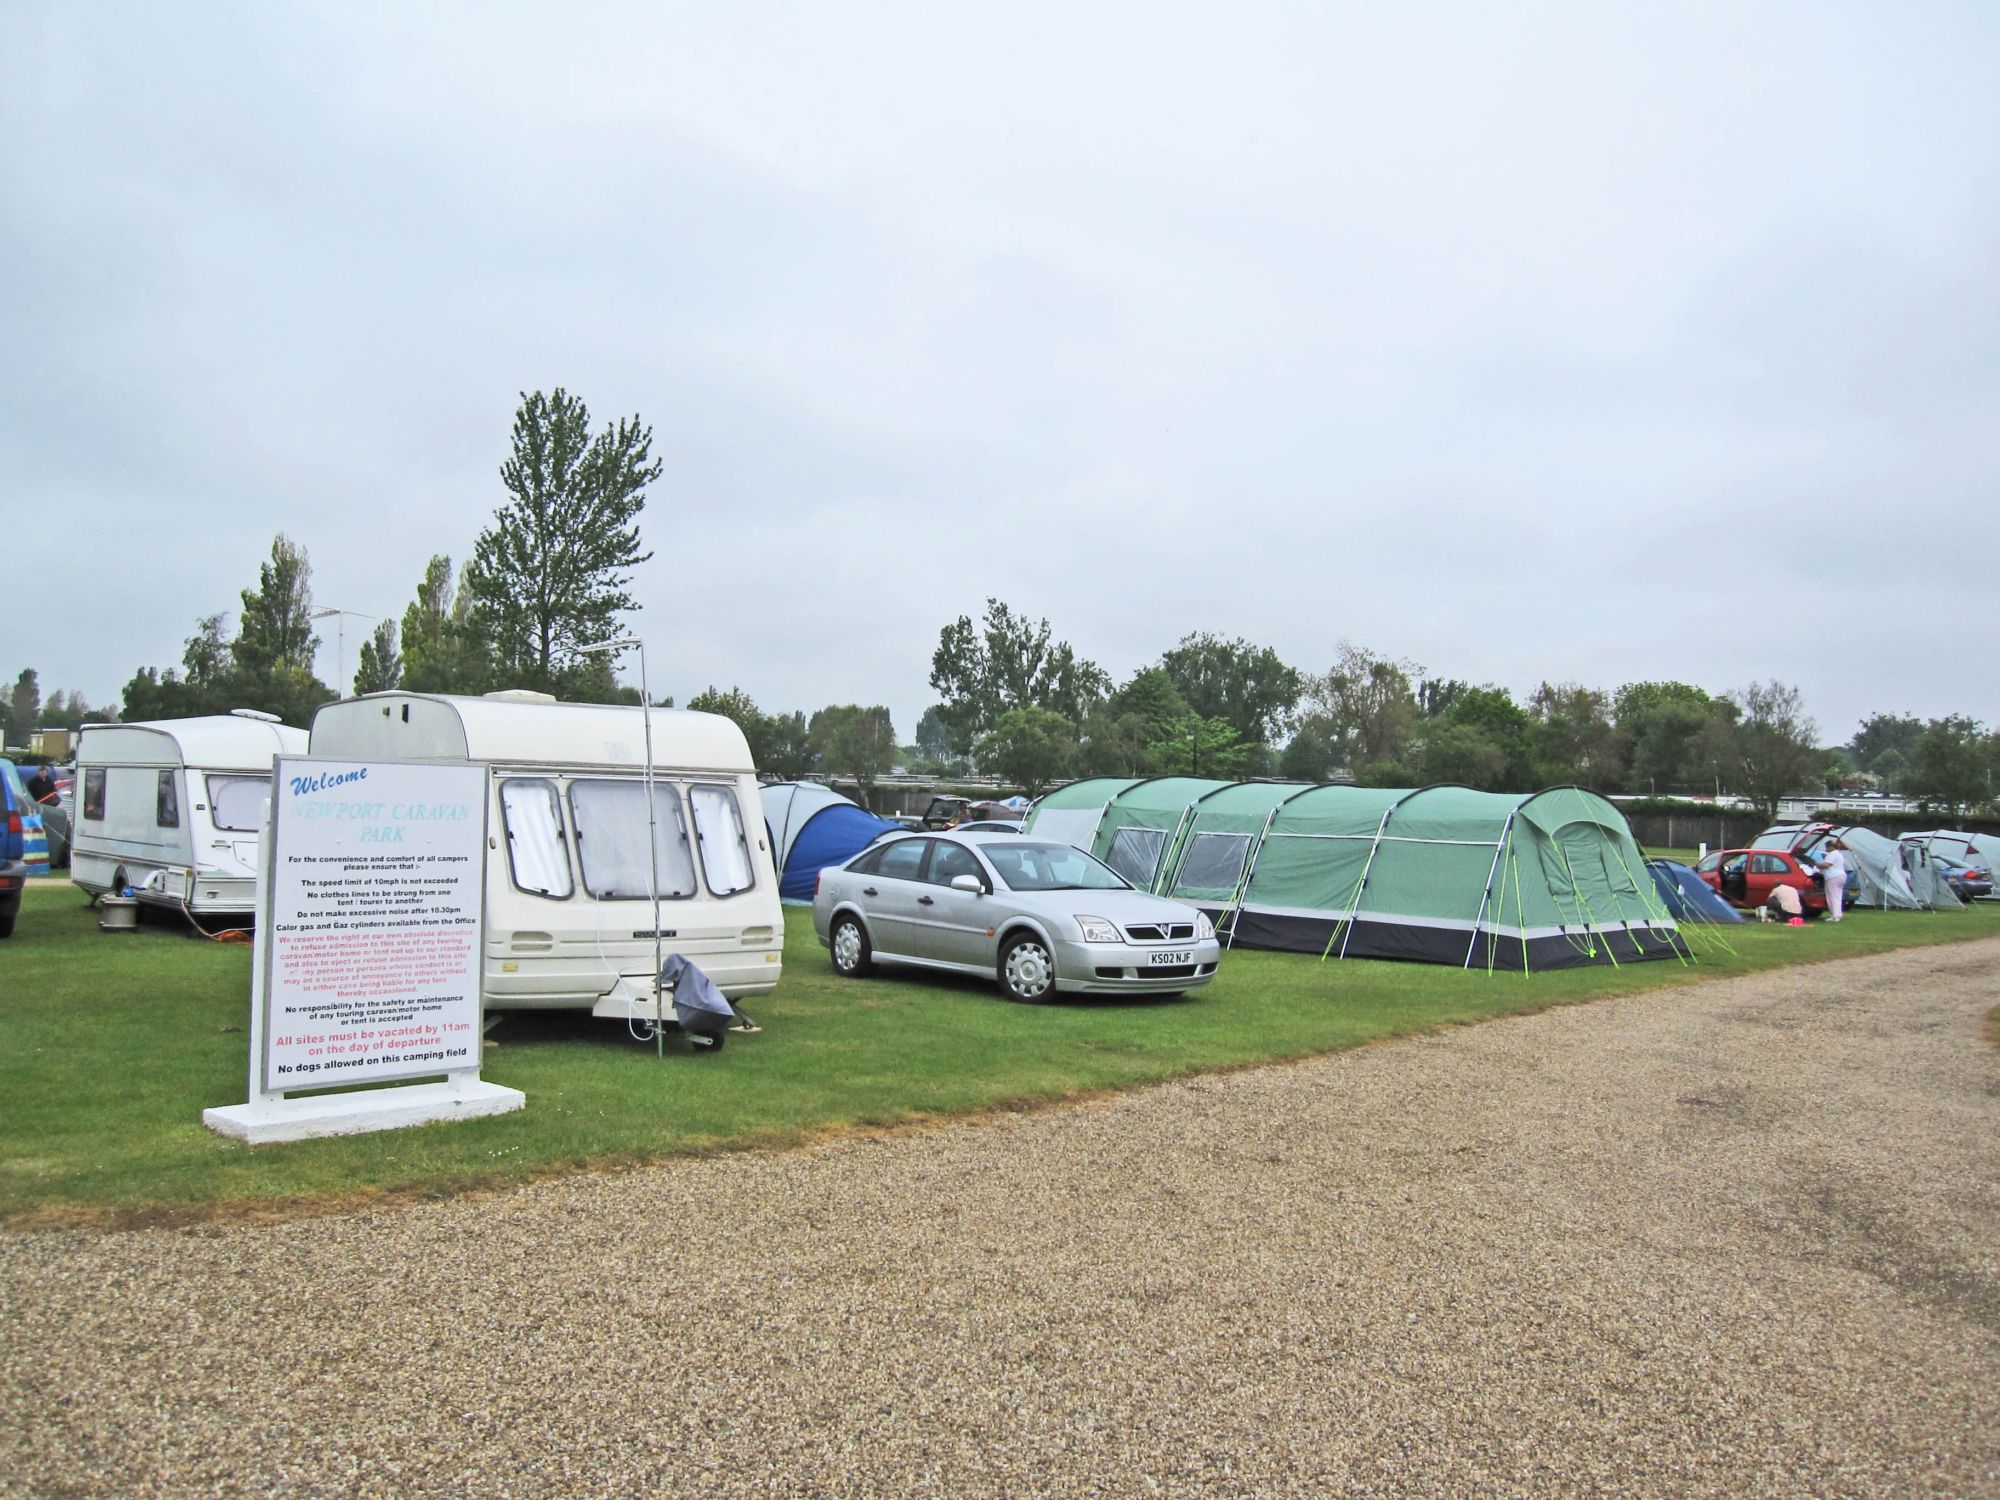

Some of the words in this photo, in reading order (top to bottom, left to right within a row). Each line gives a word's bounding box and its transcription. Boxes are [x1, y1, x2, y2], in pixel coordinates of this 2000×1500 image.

[290, 768, 368, 796] Welcome
[291, 802, 385, 819] NEWPORT
[391, 803, 471, 820] CARAVAN
[360, 826, 406, 842] PARK
[343, 864, 369, 872] please
[319, 879, 343, 887] speed
[374, 878, 400, 886] 10mph
[350, 921, 385, 929] cylinders
[387, 919, 421, 927] available
[341, 934, 360, 942] right
[328, 941, 369, 949] admission
[330, 958, 351, 966] eject
[1151, 954, 1174, 963] KS02
[1176, 952, 1191, 963] NJF
[316, 968, 345, 976] person
[440, 967, 466, 975] without
[312, 983, 337, 991] either
[337, 989, 367, 997] thereby
[299, 1002, 353, 1013] responsibility
[416, 996, 463, 1004] maintenance
[378, 1013, 413, 1023] accepted
[277, 1036, 293, 1046] All
[295, 1034, 325, 1044] sites
[328, 1030, 359, 1042] must
[361, 1030, 375, 1039] be
[378, 1025, 423, 1037] vacated
[424, 1024, 438, 1035] by
[442, 1022, 470, 1032] 11am
[309, 1048, 323, 1056] on
[326, 1044, 345, 1054] the
[349, 1042, 371, 1053] day
[373, 1040, 384, 1050] of
[388, 1036, 441, 1049] departure
[278, 1064, 293, 1073] No
[296, 1063, 321, 1073] dogs
[324, 1057, 364, 1069] allowed
[382, 1054, 400, 1063] this
[403, 1050, 444, 1061] camping
[446, 1047, 467, 1057] field
